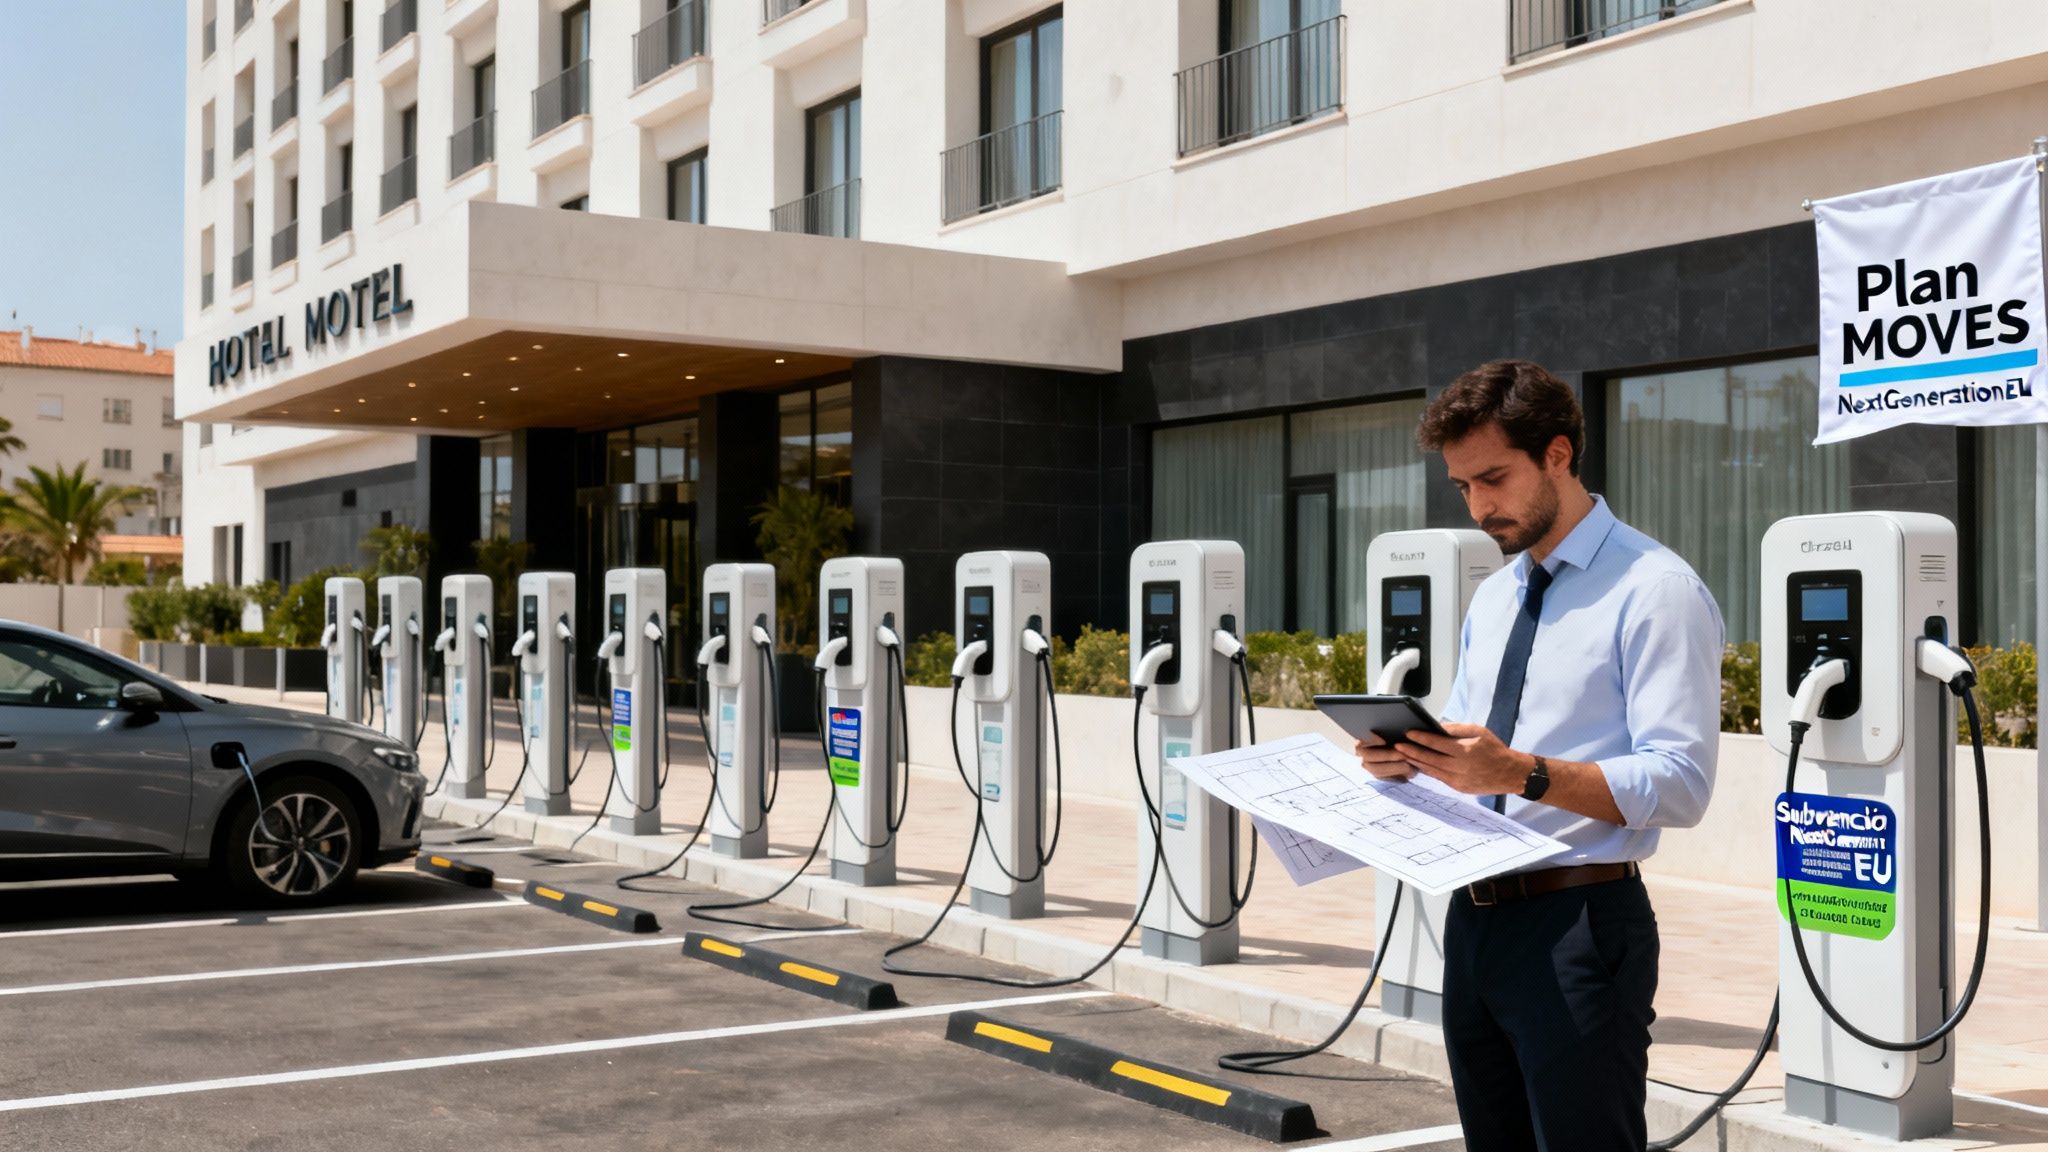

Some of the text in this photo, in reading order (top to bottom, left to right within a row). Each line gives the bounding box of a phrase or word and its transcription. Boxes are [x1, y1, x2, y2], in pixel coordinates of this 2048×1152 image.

[305, 263, 413, 351] MOTEL
[1858, 259, 1978, 312] Plan
[1843, 299, 2030, 365] MOVES
[1854, 852, 1892, 885] EU
